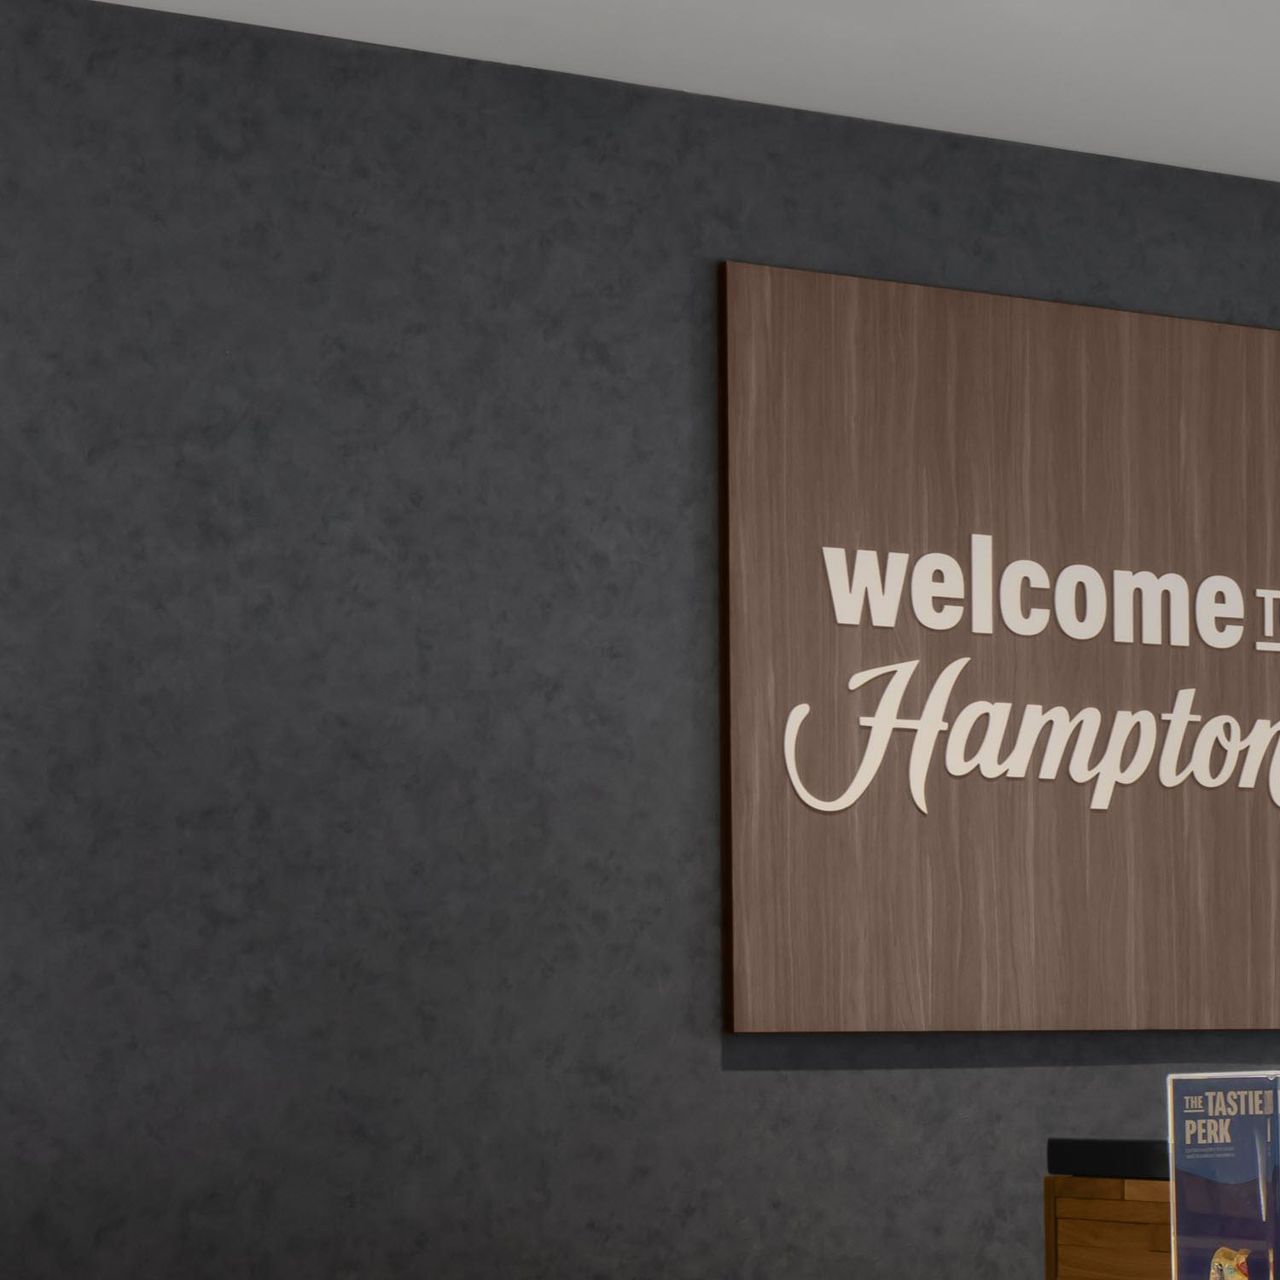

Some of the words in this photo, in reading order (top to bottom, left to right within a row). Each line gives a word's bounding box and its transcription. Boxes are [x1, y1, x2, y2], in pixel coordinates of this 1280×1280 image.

[822, 534, 1246, 649] welcome
[1184, 1095, 1203, 1110] THE
[1185, 1119, 1231, 1144] PERK
